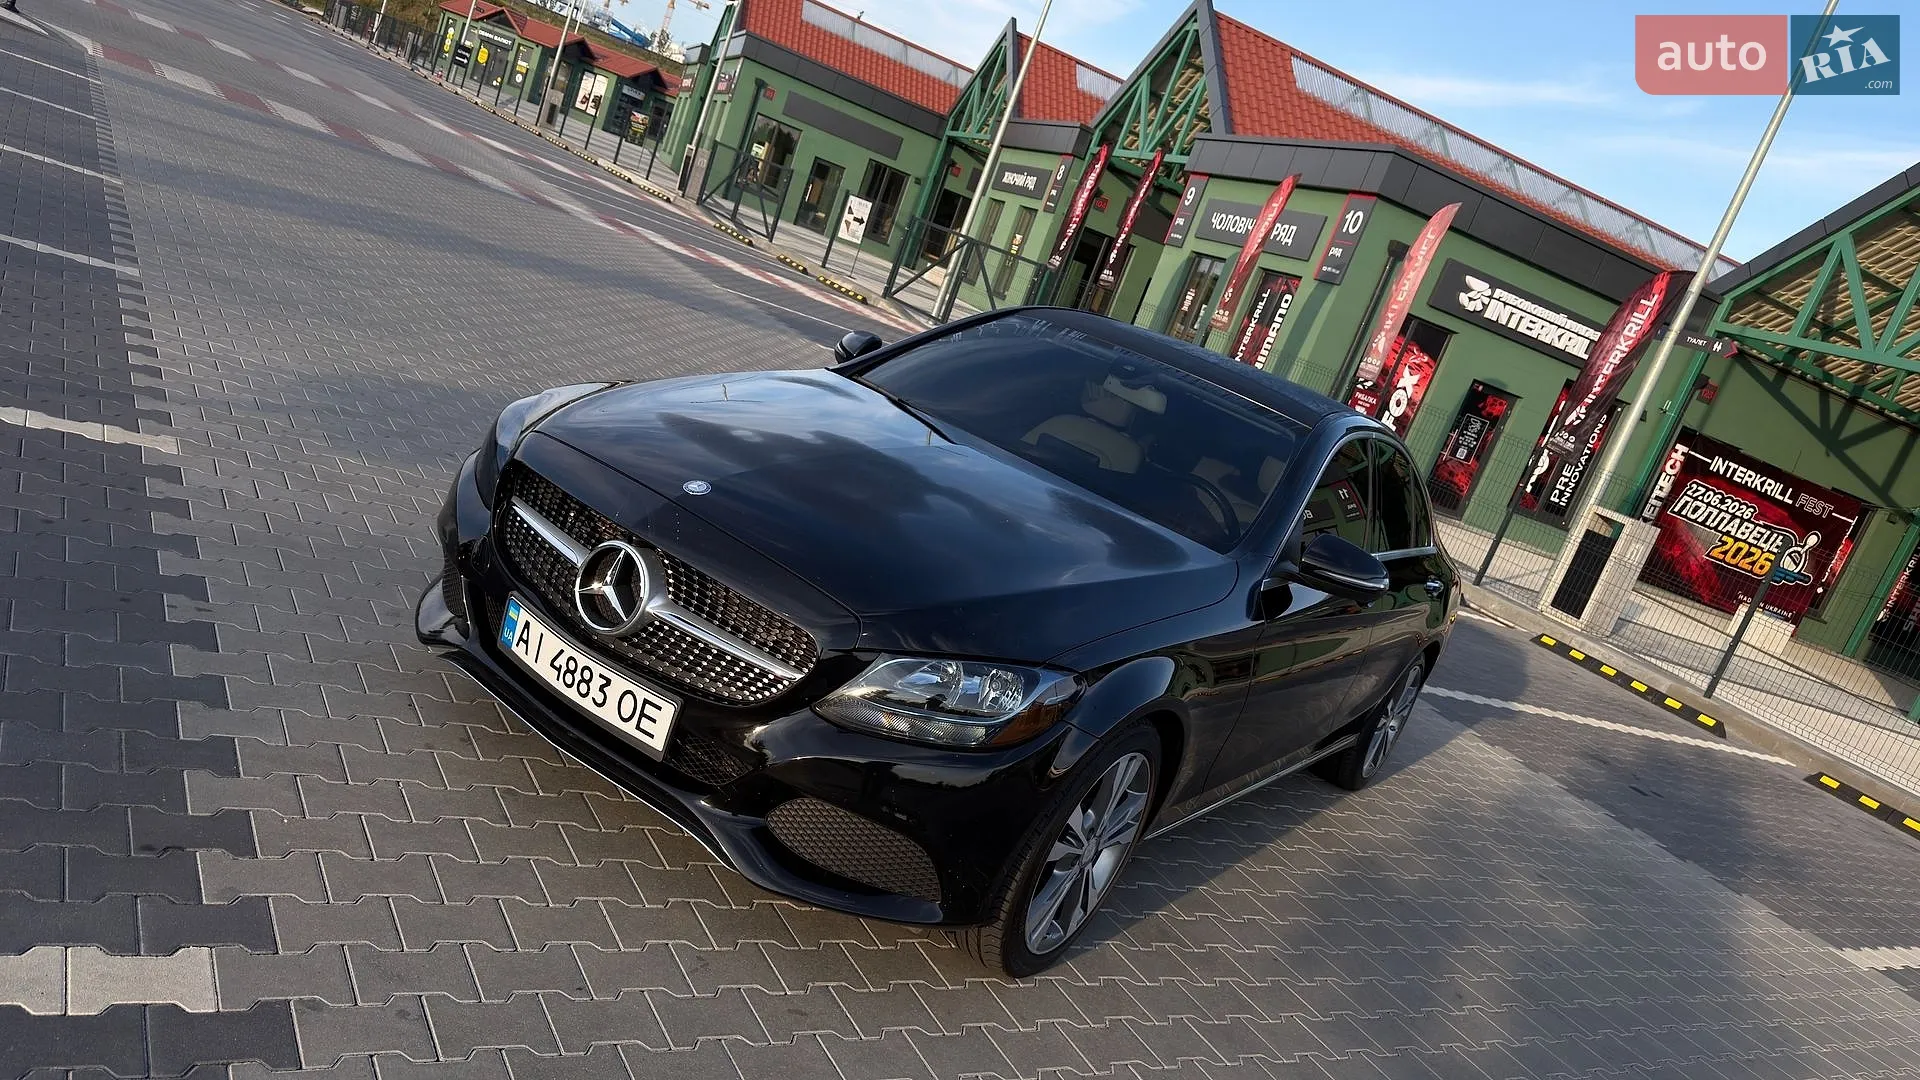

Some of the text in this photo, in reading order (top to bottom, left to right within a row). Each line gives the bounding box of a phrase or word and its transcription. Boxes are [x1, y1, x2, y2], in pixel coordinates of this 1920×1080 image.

[1056, 164, 1066, 181] 8
[1184, 187, 1196, 206] 9
[1211, 212, 1297, 246] ЧОЛОВІЧ РЯД
[1342, 210, 1364, 234] 10
[1234, 288, 1271, 362] NTERKRILL
[1483, 298, 1591, 360] INTERKRIL
[1584, 292, 1659, 405] INTERKRILL
[1381, 363, 1420, 432] FOX
[1549, 463, 1576, 503] PRE
[1686, 482, 1755, 520] 27.06.2026
[1709, 455, 1834, 519] INTERKRILL FEST
[1709, 535, 1775, 577] 2026
[1738, 593, 1752, 603] MAD
[504, 626, 513, 641] UA
[515, 619, 662, 740] AI 4883 OE
